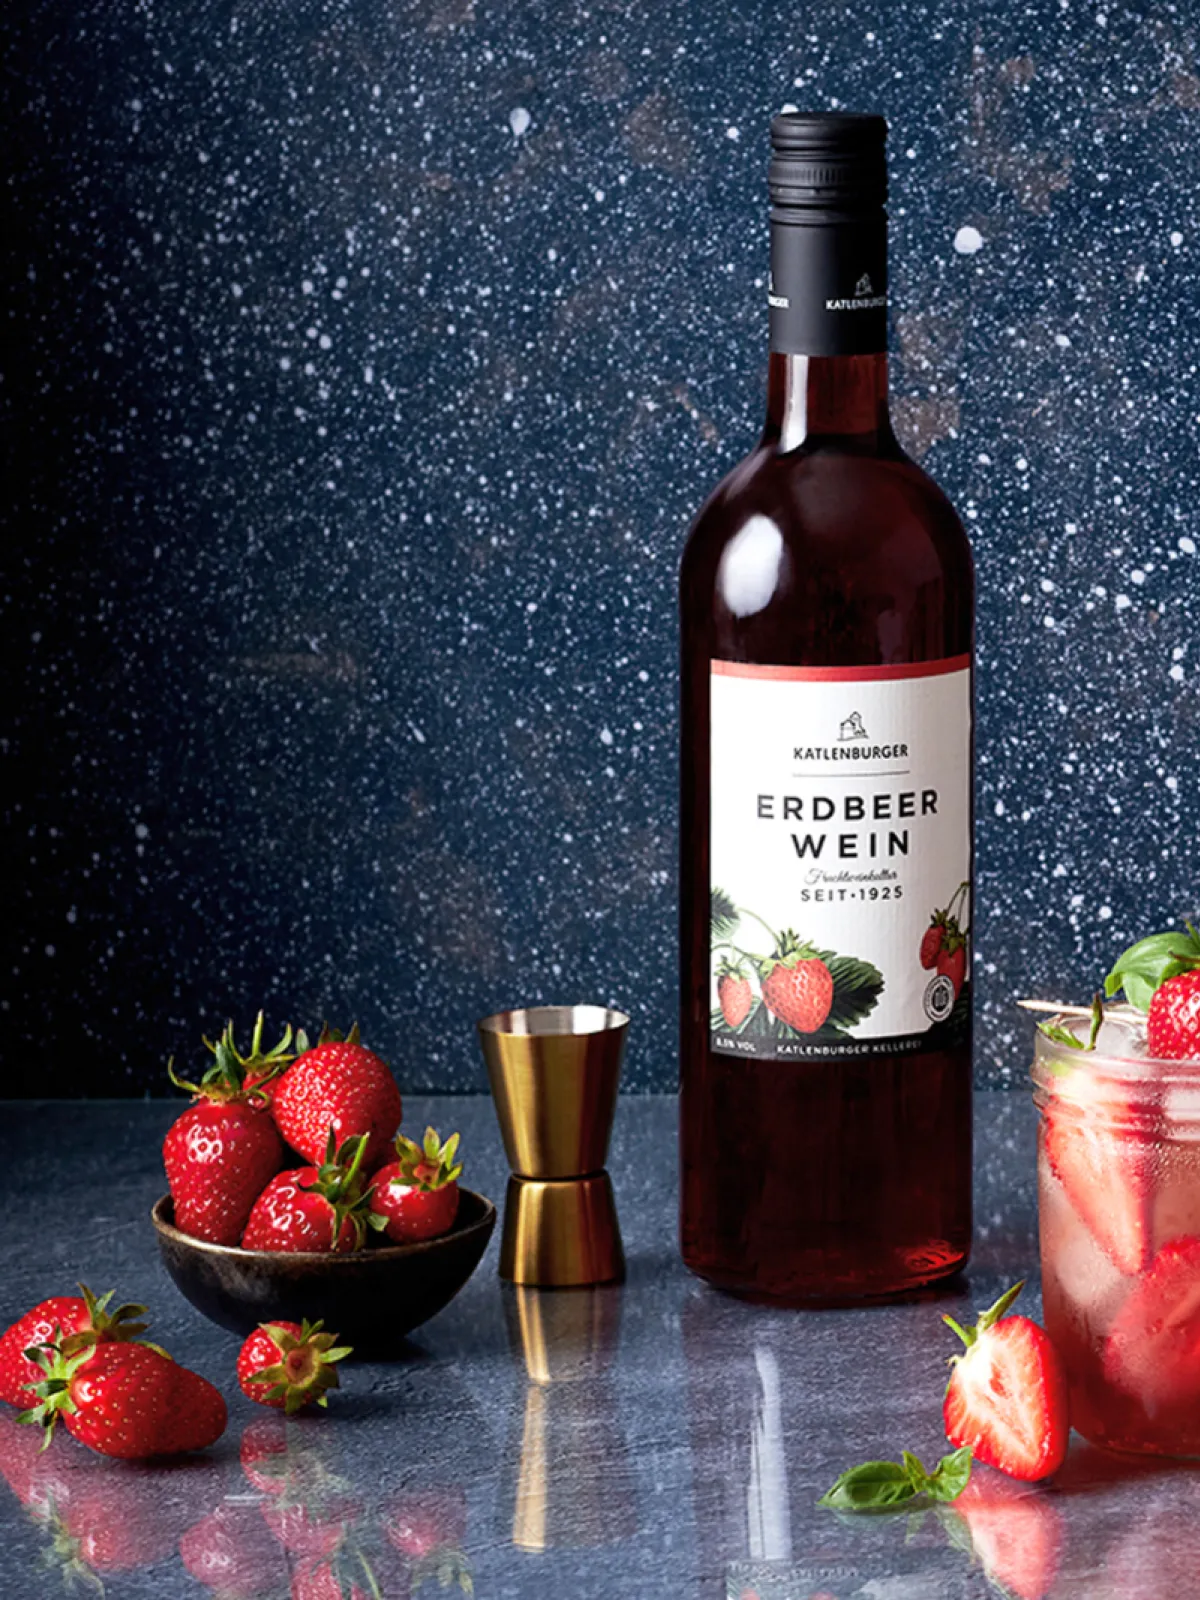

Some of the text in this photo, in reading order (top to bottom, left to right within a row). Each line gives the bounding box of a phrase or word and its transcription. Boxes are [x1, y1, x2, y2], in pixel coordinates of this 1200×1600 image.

[793, 744, 908, 760] KATLENBURGER
[757, 789, 938, 821] ERDBEER
[791, 830, 908, 859] WEIN
[777, 1044, 869, 1055] KATLENBURGER
